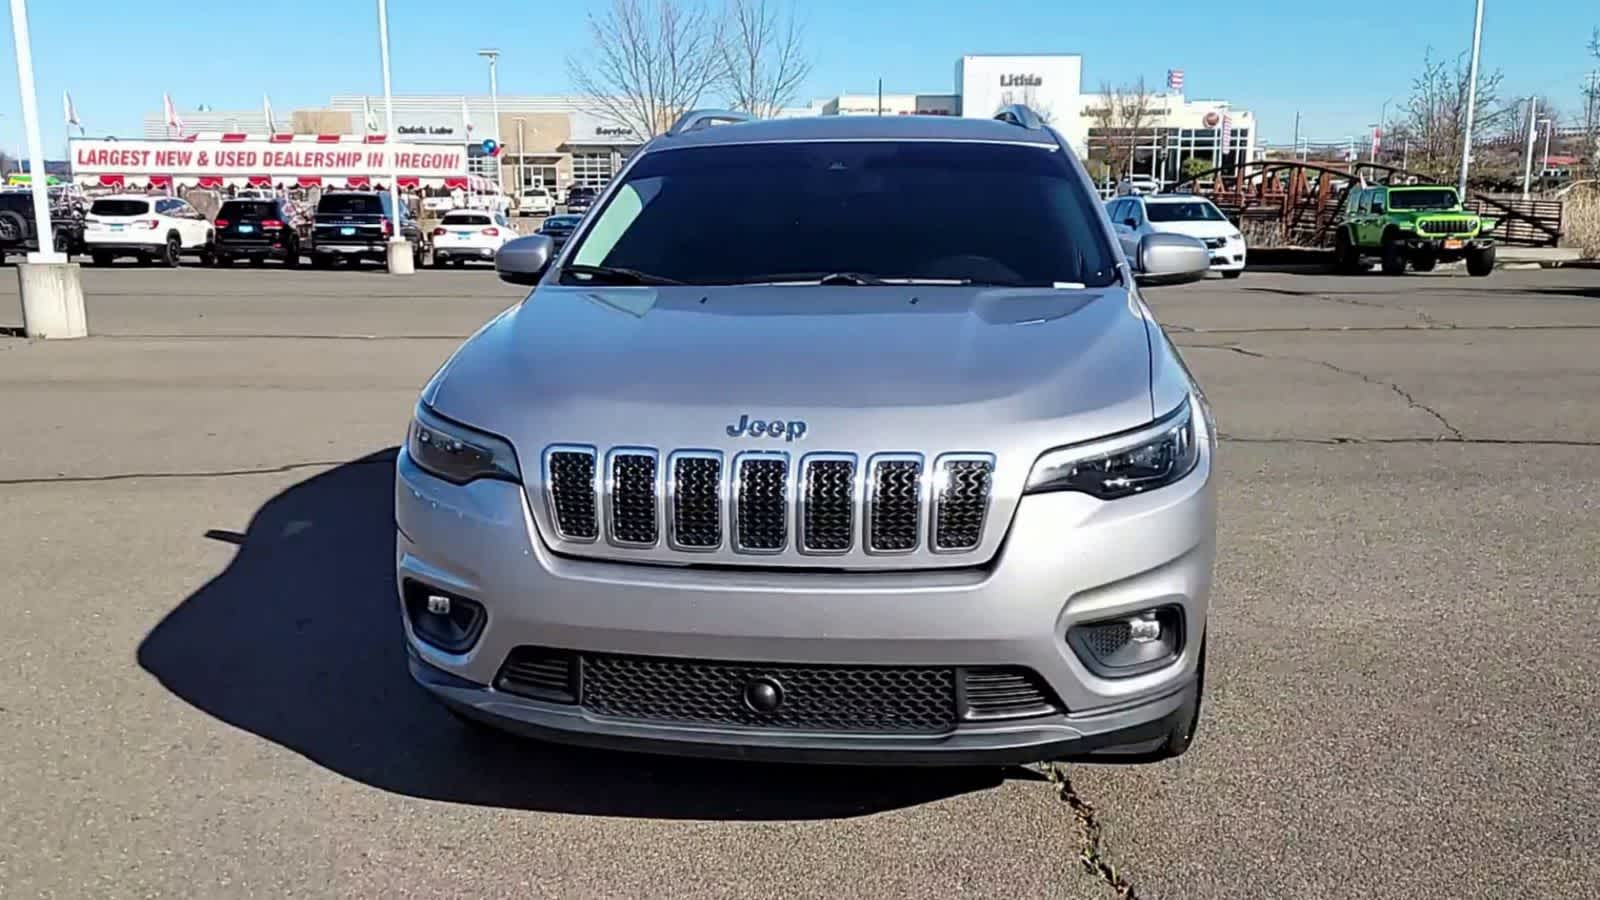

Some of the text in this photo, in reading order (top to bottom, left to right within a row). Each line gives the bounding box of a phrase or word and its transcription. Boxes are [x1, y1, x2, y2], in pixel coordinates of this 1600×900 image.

[1000, 73, 1042, 87] Lithia
[398, 126, 453, 134] Quick Lube
[596, 127, 632, 136] Service
[77, 149, 149, 167] LARGEST
[155, 151, 192, 167] NEW
[197, 152, 208, 167] &
[215, 151, 257, 167] USED
[263, 151, 362, 168] DEALERSHIP
[367, 152, 384, 168] IN
[726, 414, 807, 442] Jeep
